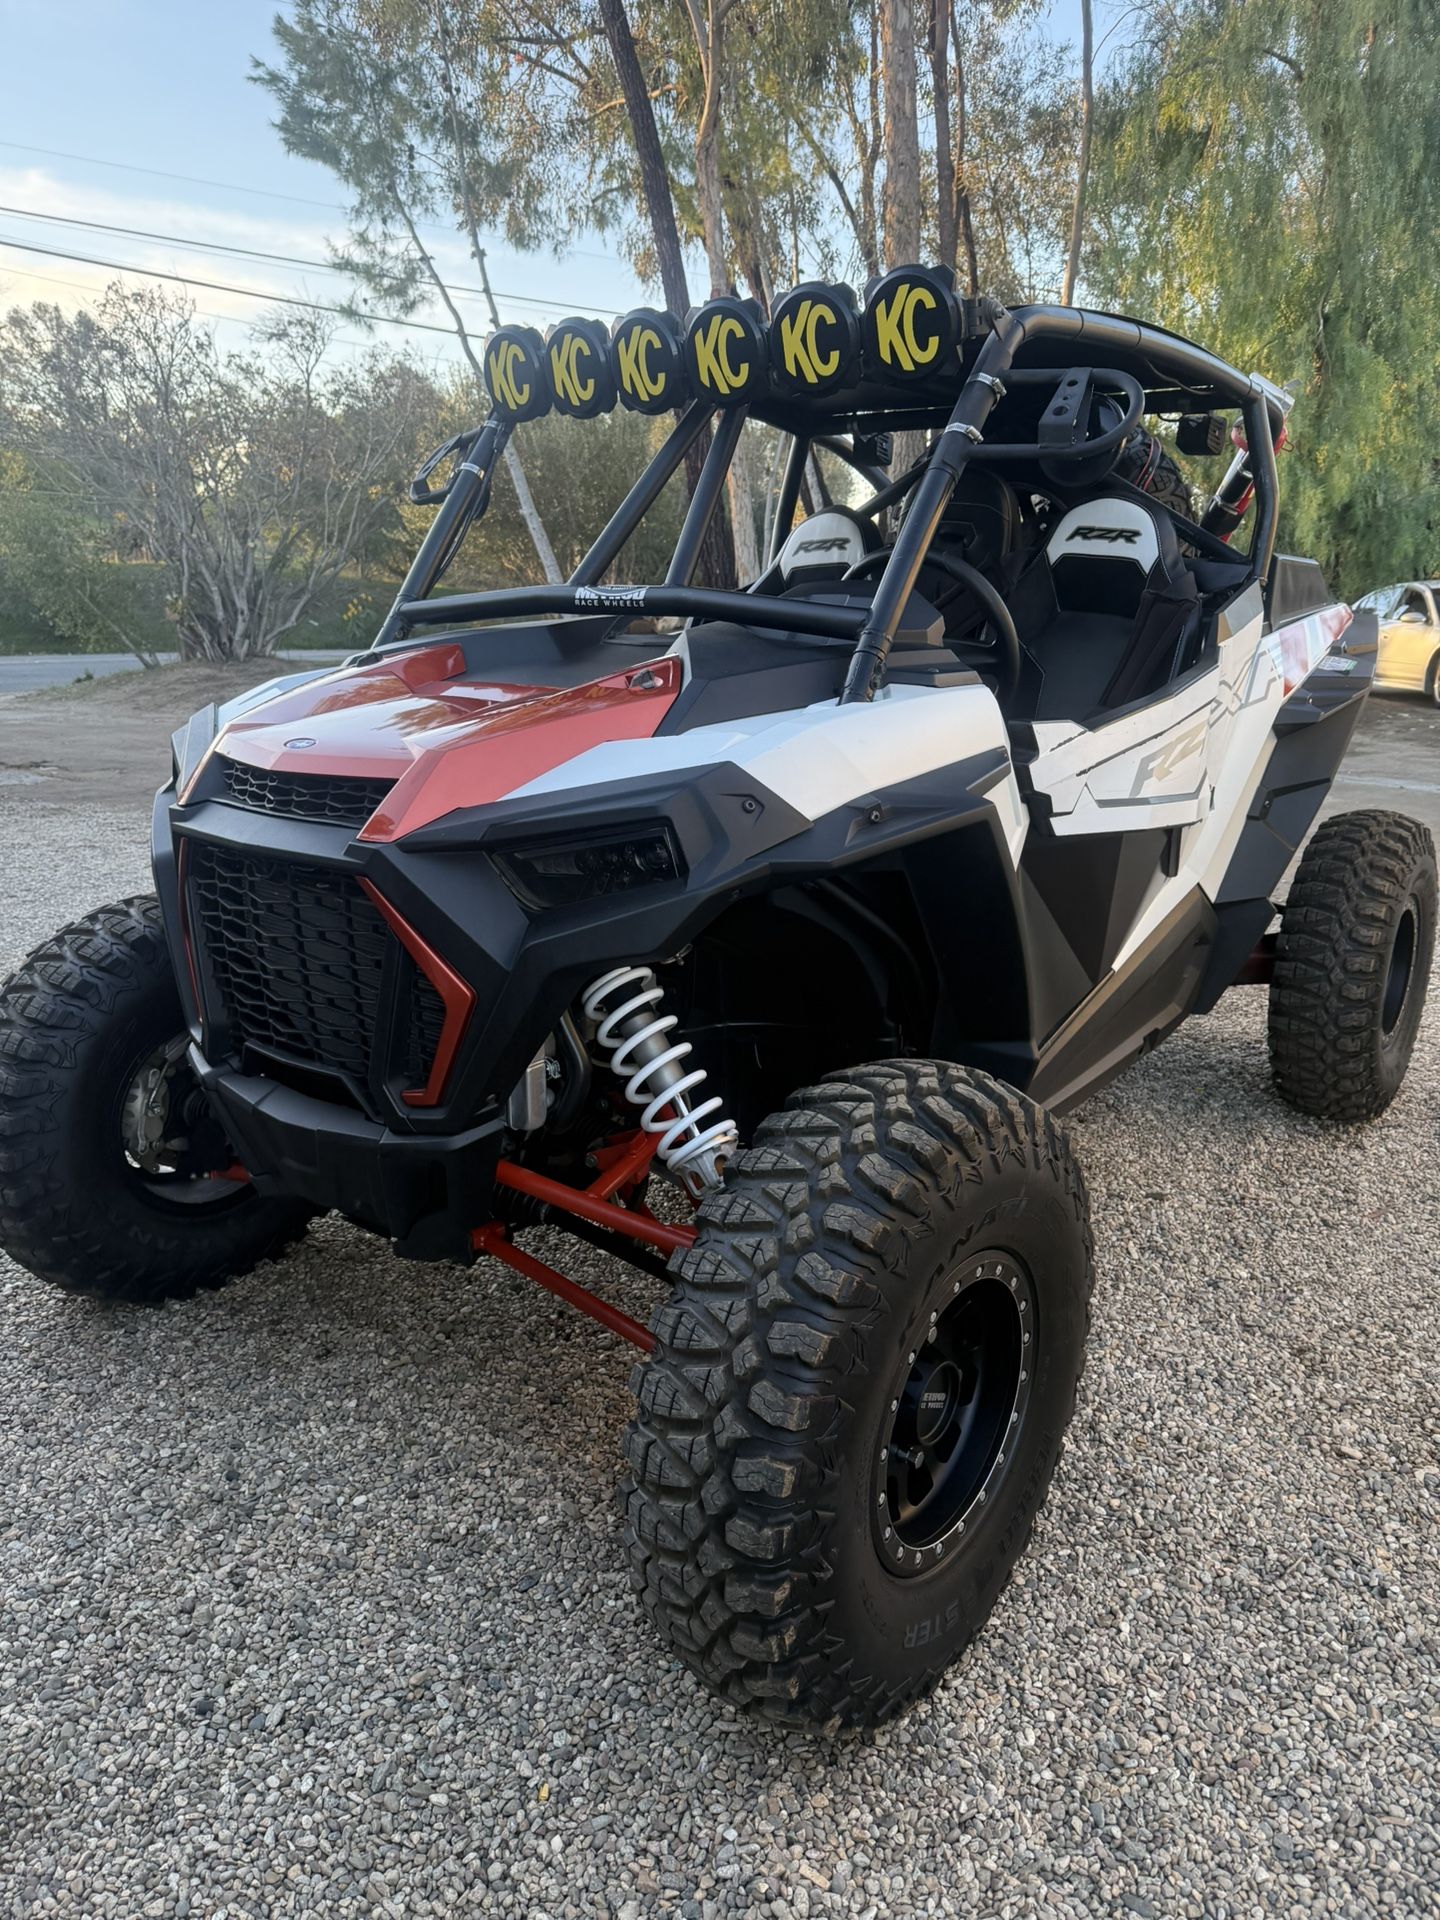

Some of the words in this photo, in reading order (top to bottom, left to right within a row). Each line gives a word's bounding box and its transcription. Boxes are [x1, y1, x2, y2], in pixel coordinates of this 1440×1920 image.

[617, 325, 666, 401] KC
[694, 314, 749, 394] KC
[781, 300, 840, 384] KC
[876, 283, 938, 371] KC
[489, 340, 530, 410] KC
[551, 333, 595, 406] KC
[791, 537, 851, 555] RZR
[1065, 525, 1143, 544] RZR
